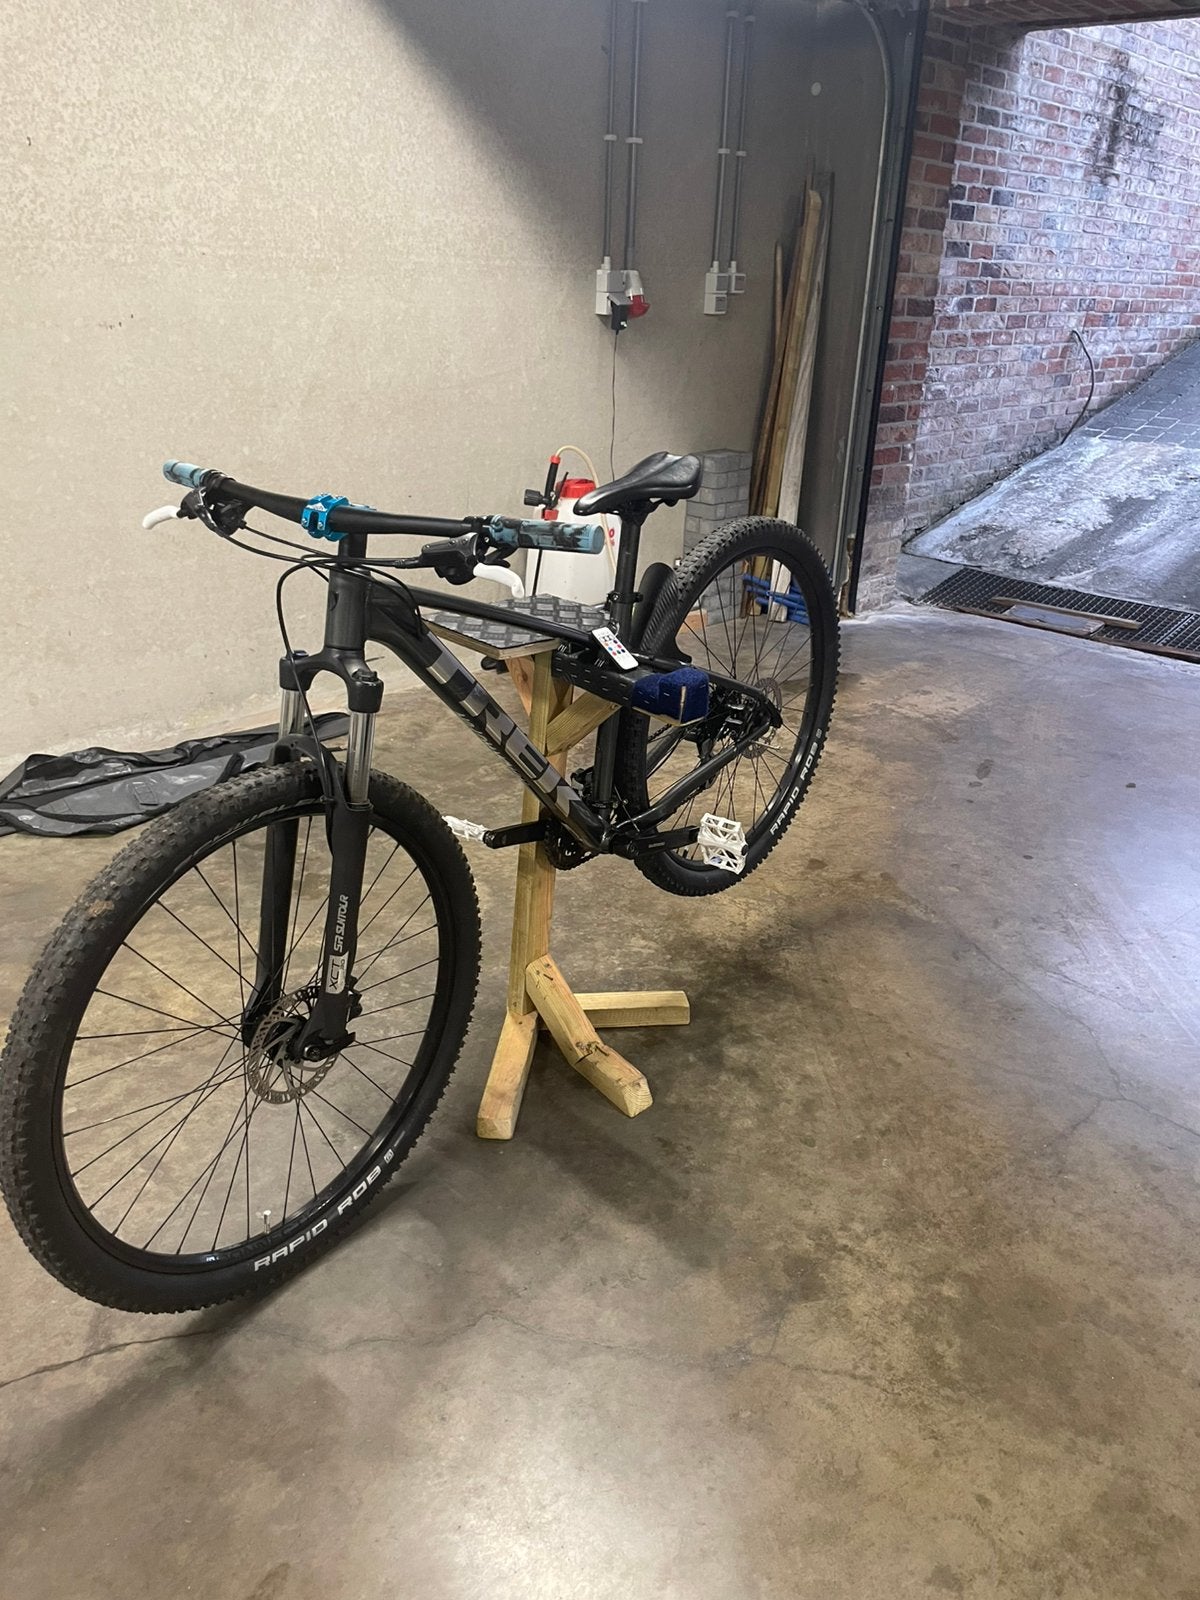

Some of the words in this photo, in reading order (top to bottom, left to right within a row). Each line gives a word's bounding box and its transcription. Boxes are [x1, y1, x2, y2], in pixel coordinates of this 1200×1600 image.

[770, 786, 799, 835] RAPID
[336, 894, 349, 935] SUNTOUR
[329, 959, 340, 990] XCT
[254, 1218, 328, 1271] RAPID
[337, 1165, 382, 1215] ROB
